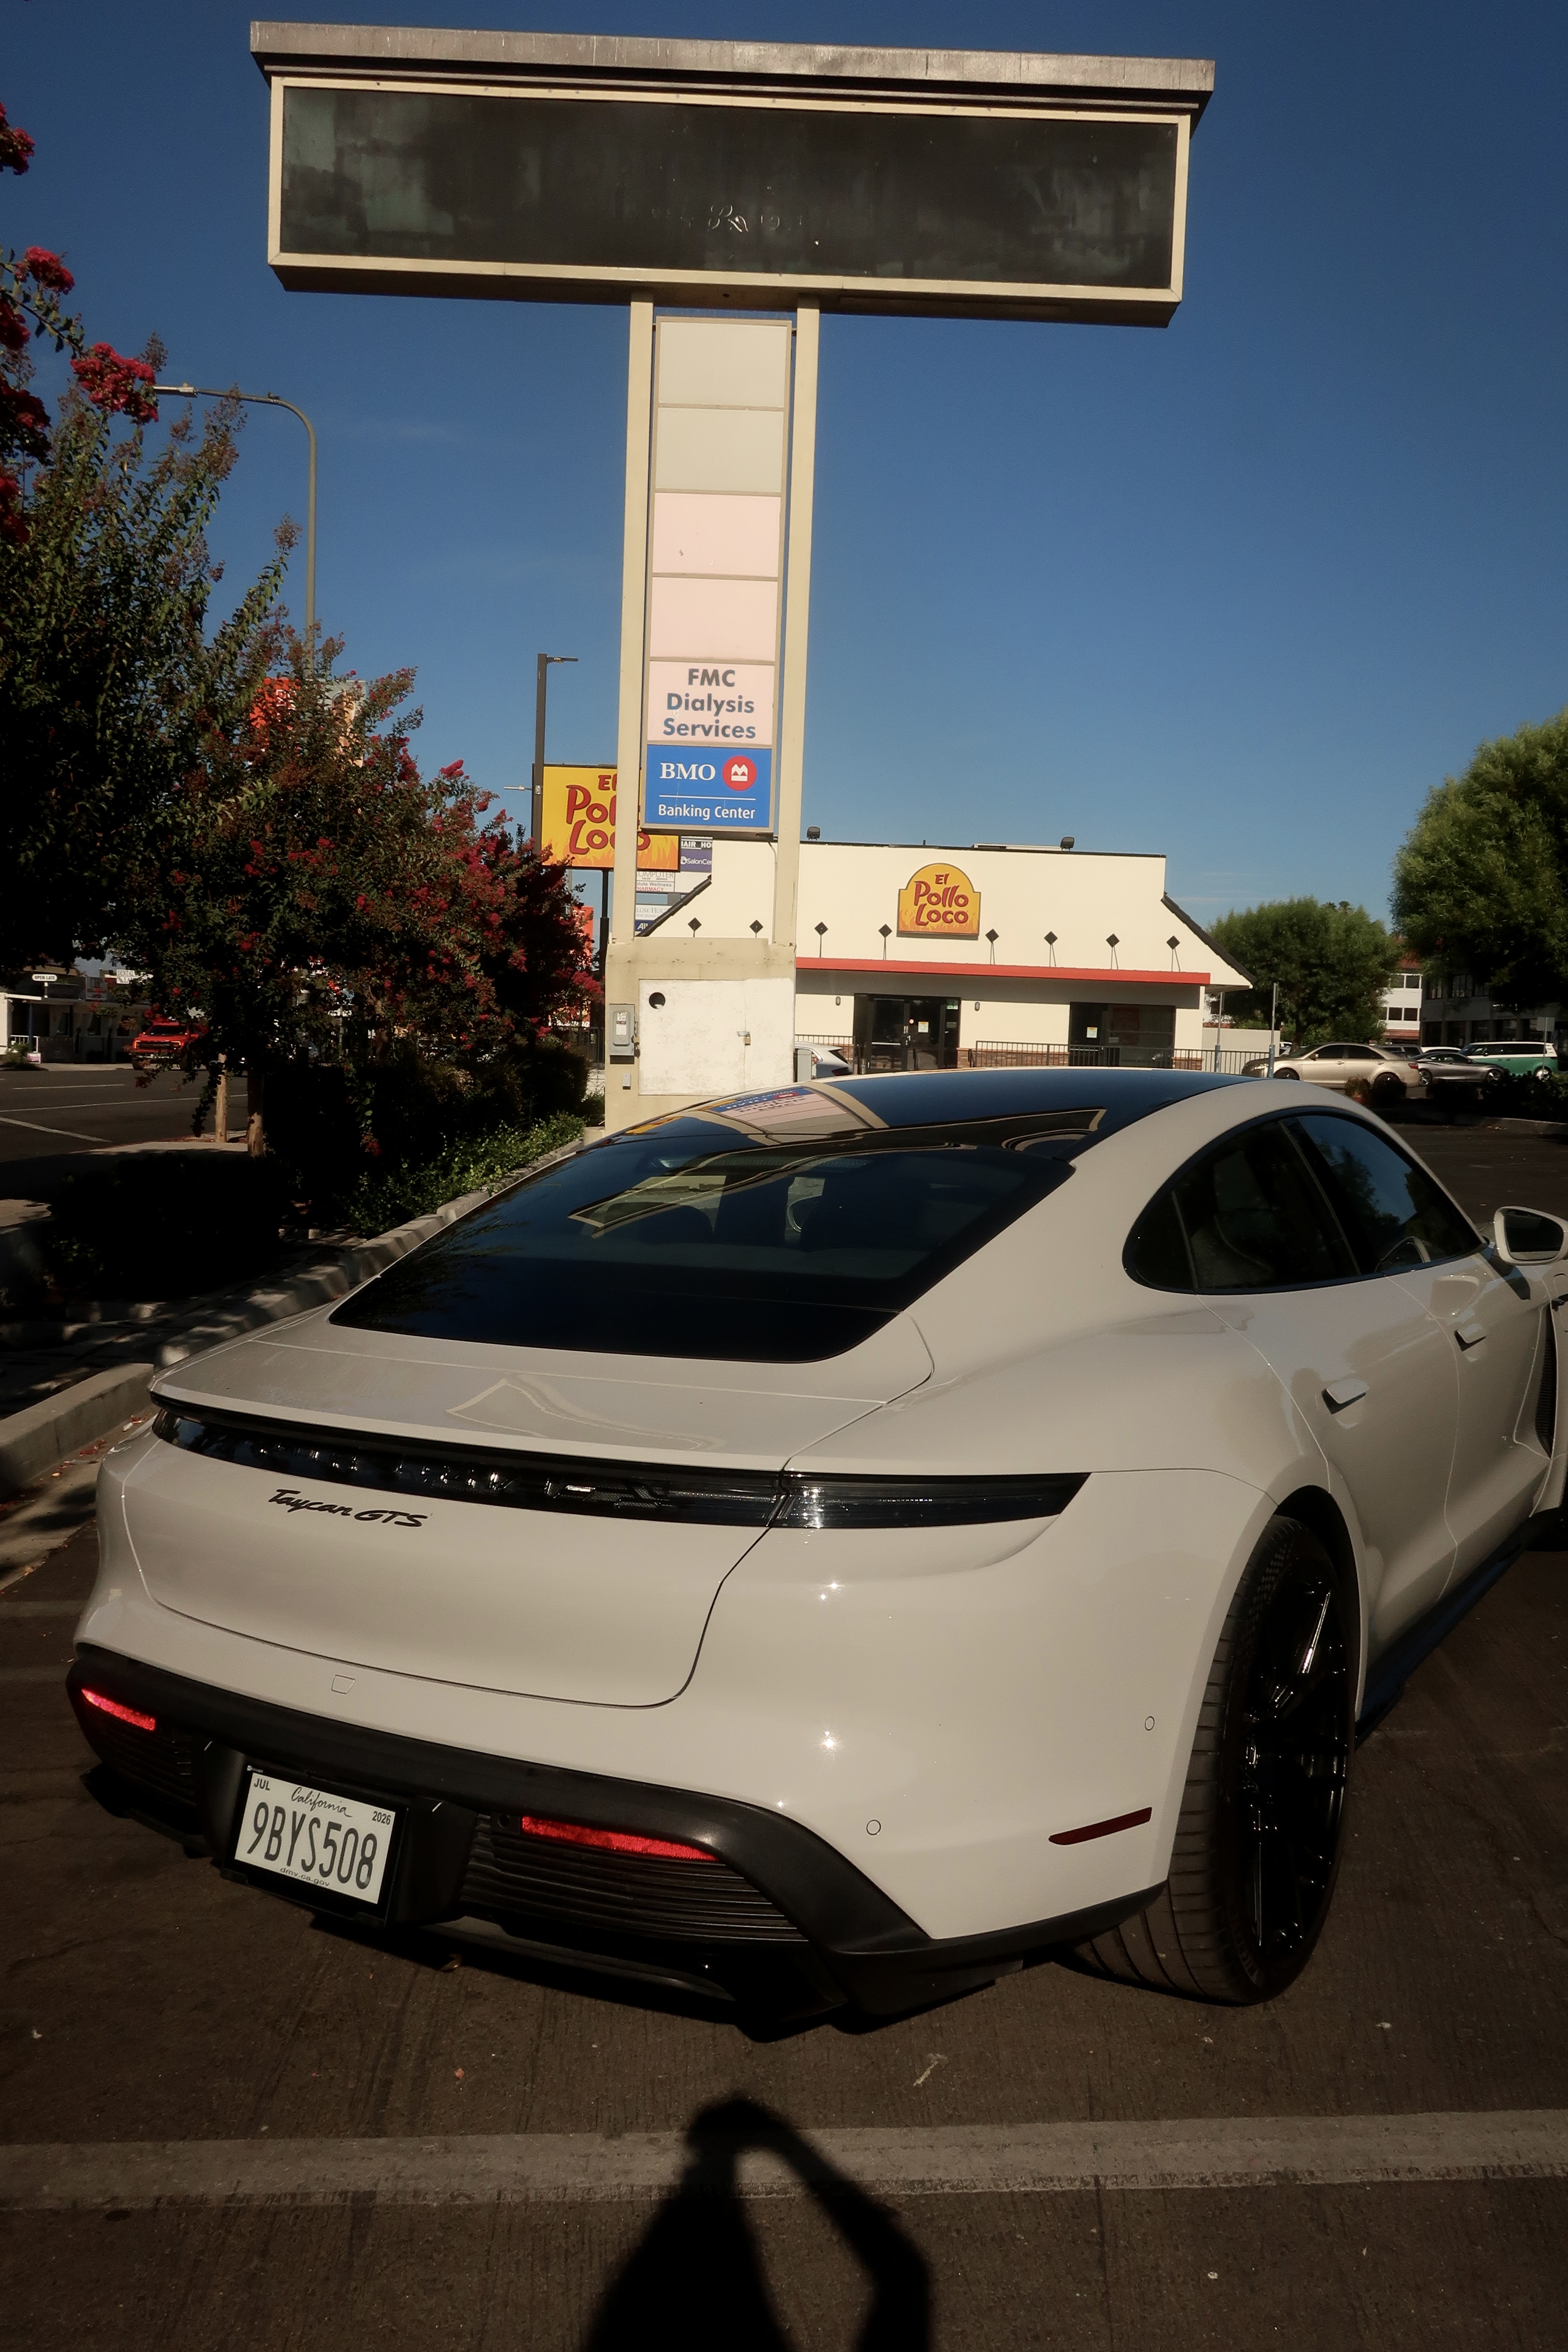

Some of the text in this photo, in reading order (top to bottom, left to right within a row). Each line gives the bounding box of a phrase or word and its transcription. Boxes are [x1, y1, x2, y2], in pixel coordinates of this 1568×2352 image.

[688, 668, 735, 687] FMC
[667, 692, 754, 717] Dialysis
[663, 717, 756, 739] Services
[660, 763, 716, 781] BMO
[658, 803, 756, 821] Banking Center
[935, 873, 949, 885] El
[914, 880, 969, 908] Pollo
[915, 903, 968, 926] Loco
[268, 1489, 428, 1527] Taycan GTS
[254, 1778, 270, 1791] JUL
[291, 1787, 353, 1817] California
[372, 1811, 392, 1825] 2026
[247, 1802, 377, 1890] 9BYS508
[280, 1868, 330, 1886] dmv.ca.gov
